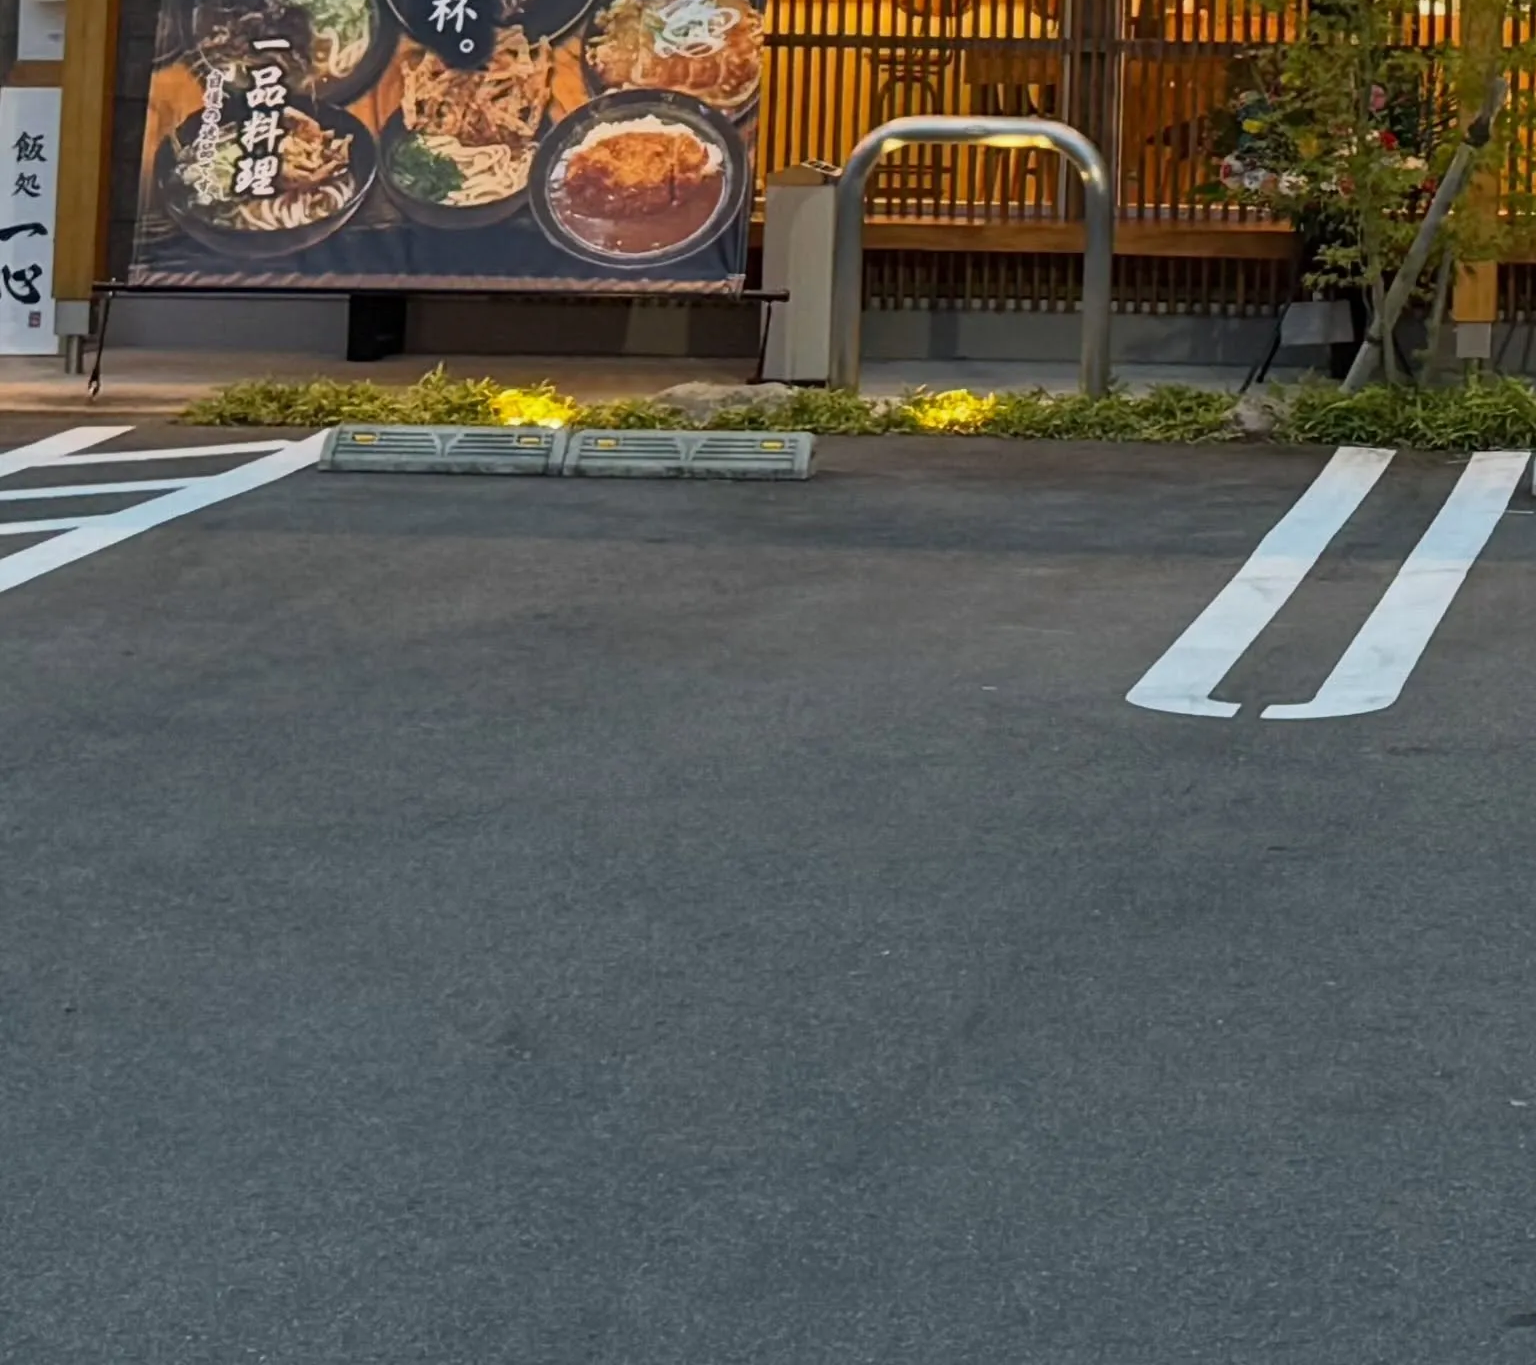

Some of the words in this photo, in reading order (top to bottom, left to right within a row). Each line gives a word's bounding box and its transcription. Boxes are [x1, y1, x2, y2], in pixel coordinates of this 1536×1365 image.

[12, 131, 47, 197] 飯処
[235, 39, 290, 195] 一品料理
